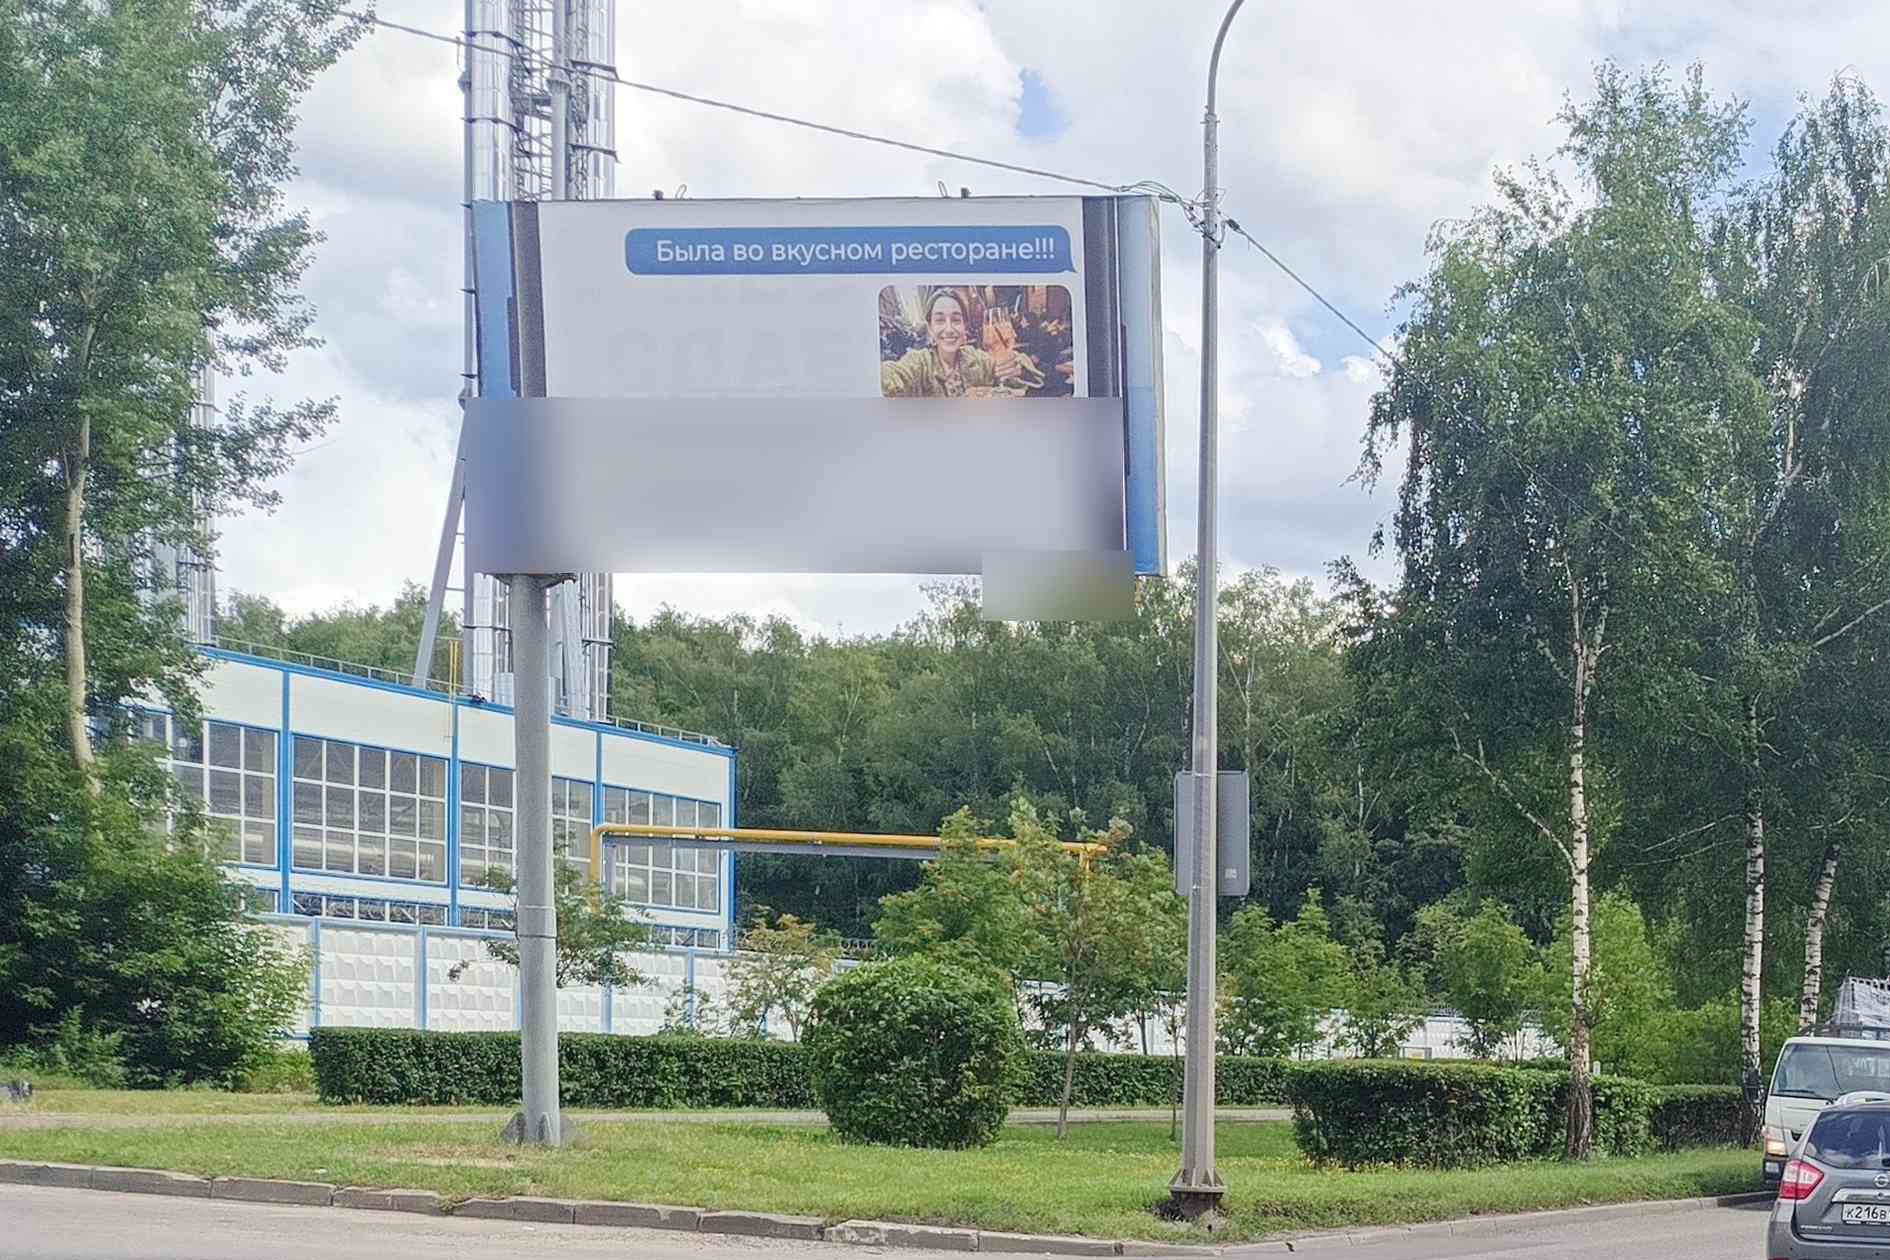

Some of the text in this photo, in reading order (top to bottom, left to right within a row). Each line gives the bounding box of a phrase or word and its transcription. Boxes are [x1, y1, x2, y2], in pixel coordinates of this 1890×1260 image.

[656, 237, 1055, 266] Была во вкусном ресторане!!!
